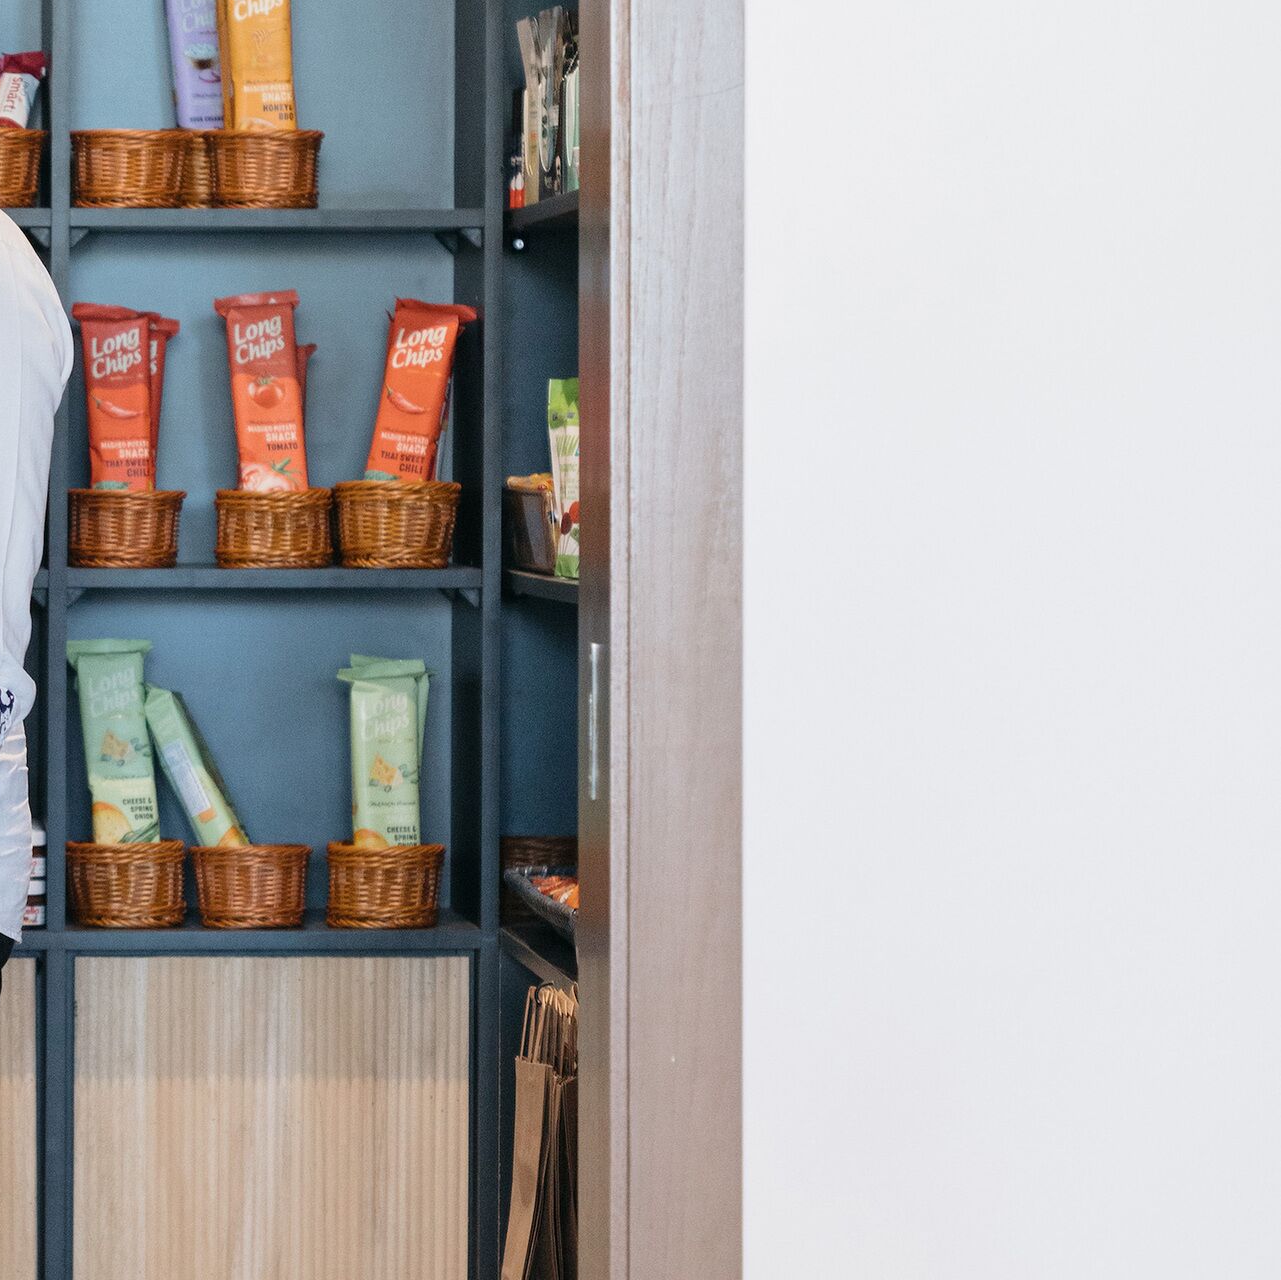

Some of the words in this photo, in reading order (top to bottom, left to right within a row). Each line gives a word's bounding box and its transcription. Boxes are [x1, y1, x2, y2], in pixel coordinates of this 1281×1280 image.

[91, 327, 140, 358] Long
[234, 315, 282, 346] Long
[396, 326, 448, 349] Long
[92, 348, 142, 379] Chips
[236, 335, 285, 365] Chips
[392, 345, 444, 369] Chips
